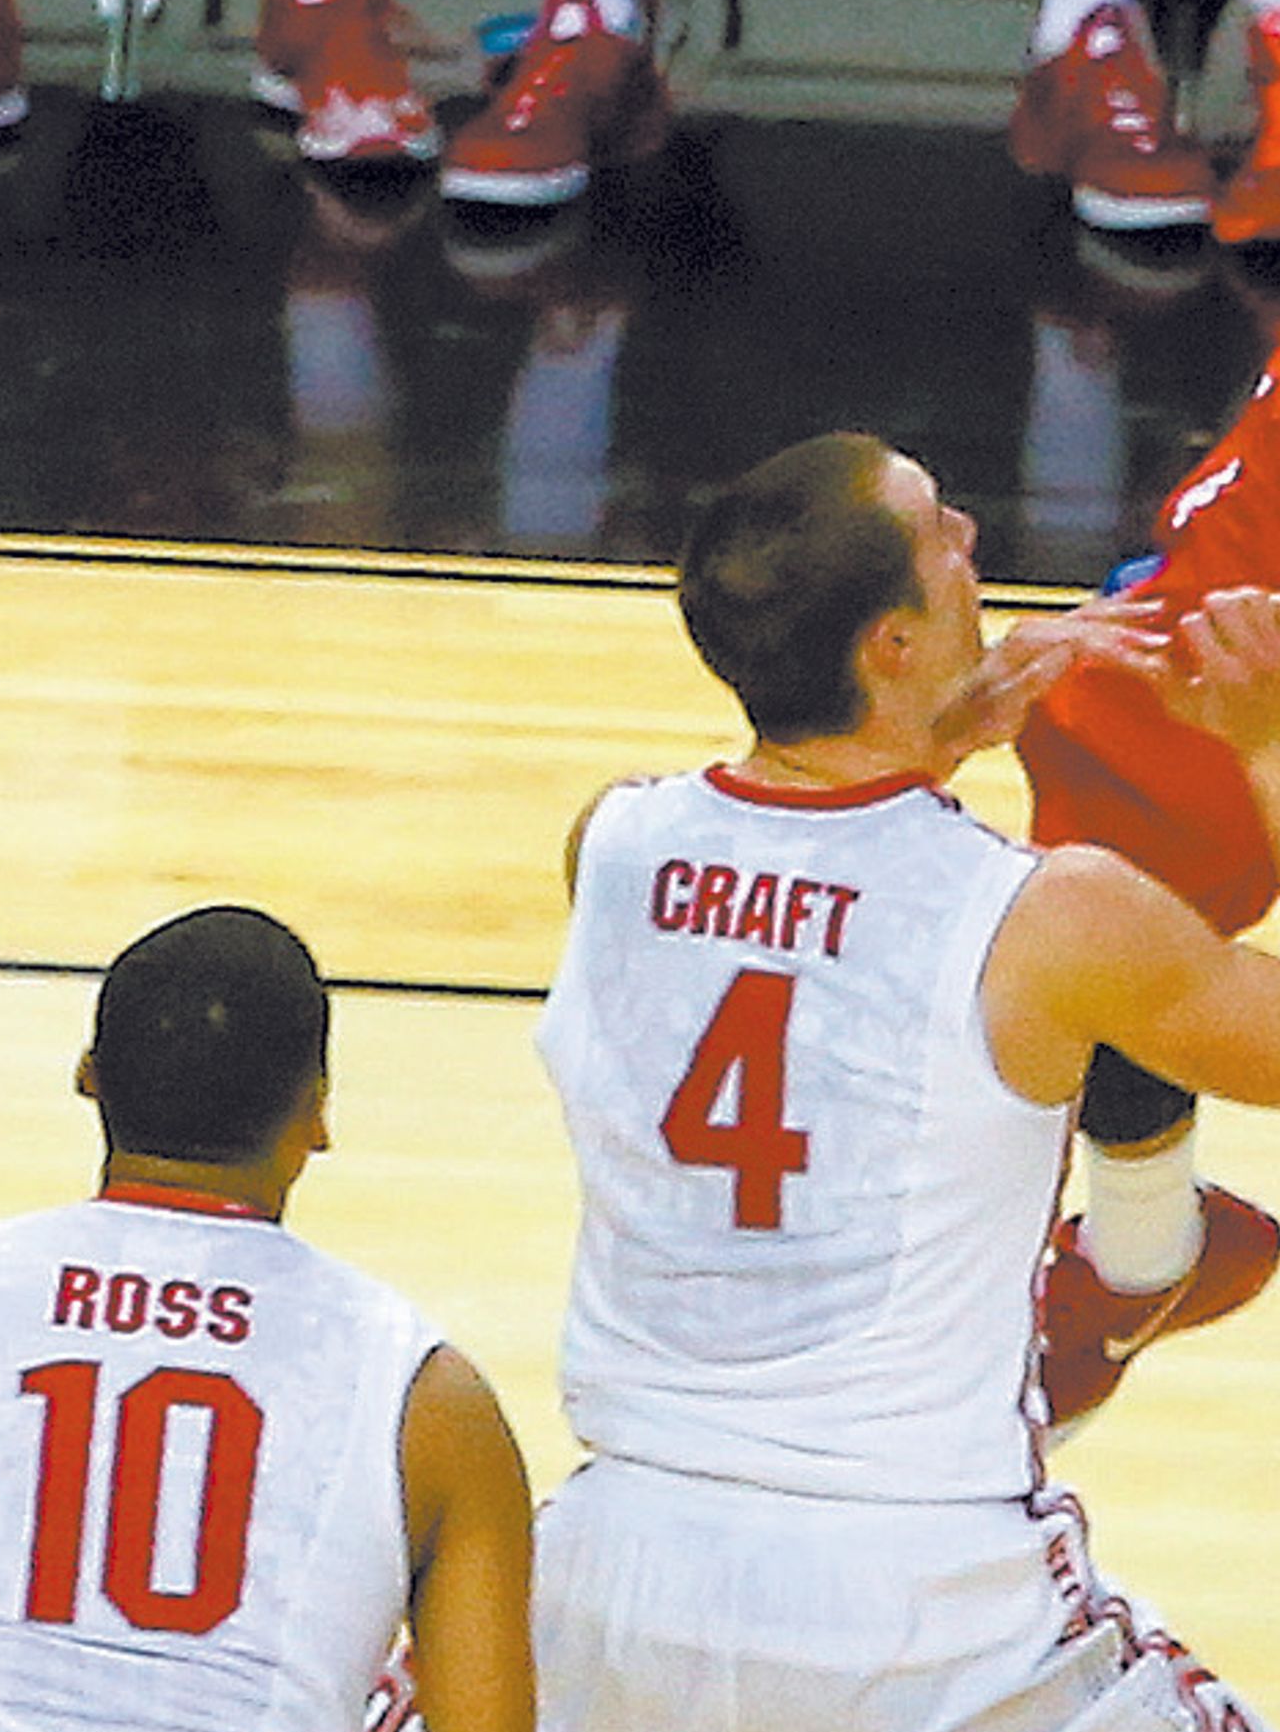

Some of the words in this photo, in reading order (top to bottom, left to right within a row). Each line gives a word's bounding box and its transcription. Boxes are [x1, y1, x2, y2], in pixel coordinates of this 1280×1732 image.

[650, 857, 862, 958] CRAFT
[658, 967, 810, 1232] 4
[50, 1263, 254, 1345] ROSS
[17, 1358, 266, 1636] 10
